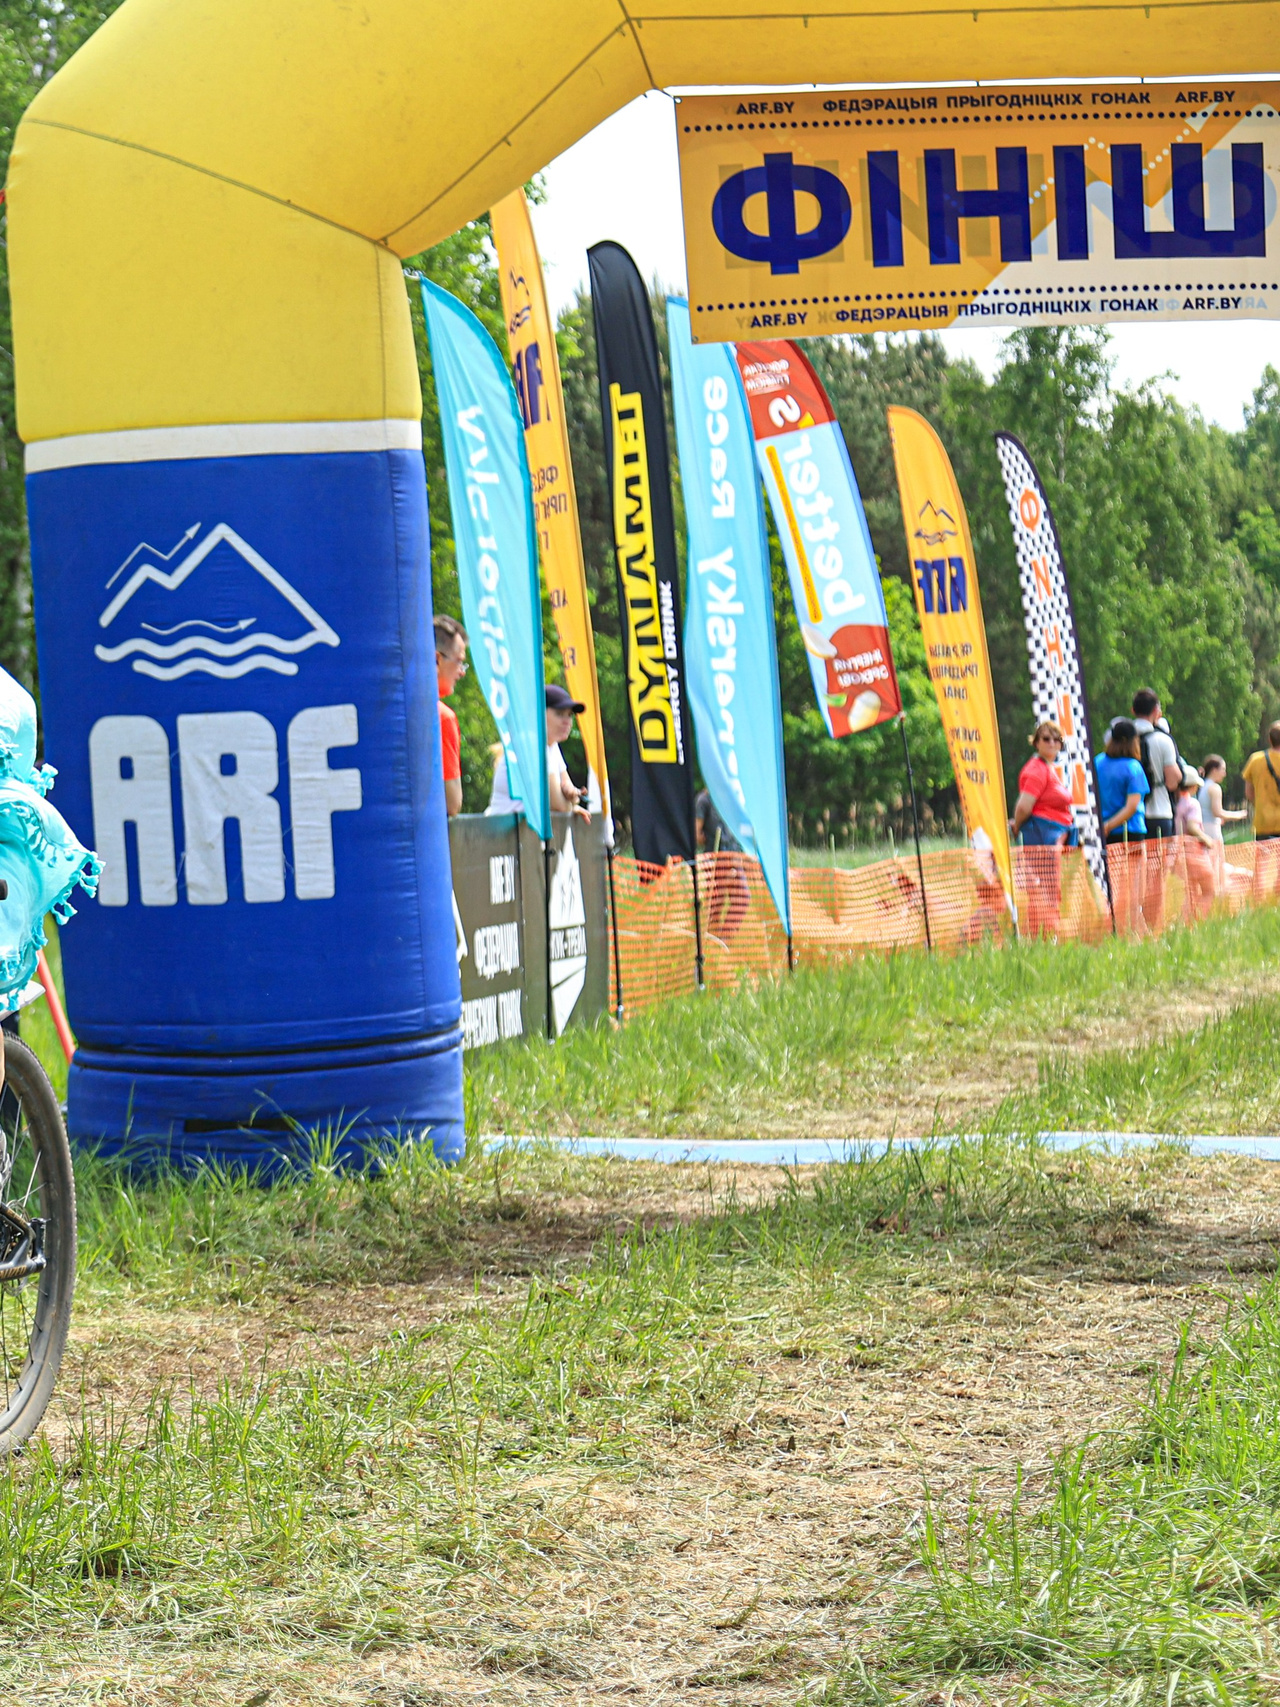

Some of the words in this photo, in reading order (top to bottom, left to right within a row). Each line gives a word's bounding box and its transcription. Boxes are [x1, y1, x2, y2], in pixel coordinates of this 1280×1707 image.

[736, 100, 794, 116] ARF.BY
[822, 96, 938, 114] ФЕДЭРАЦЫЯ
[946, 92, 1083, 111] ПРЫГОДНІЦКІХ
[1091, 91, 1151, 106] ГОНАК
[1175, 90, 1235, 104] ARF.BY
[711, 142, 1266, 275] ФІНІШ
[750, 312, 808, 328] ARF.BY
[835, 304, 948, 323] ФЕДЭРАЦЫЯ
[957, 299, 1091, 318] ПРЫГОДНІЦКІХ
[1101, 298, 1158, 312] ГОНАК
[1182, 297, 1242, 311] ARF.BY
[659, 579, 679, 661] DRINK
[666, 663, 686, 766] ENERGY
[88, 703, 363, 907] ARF
